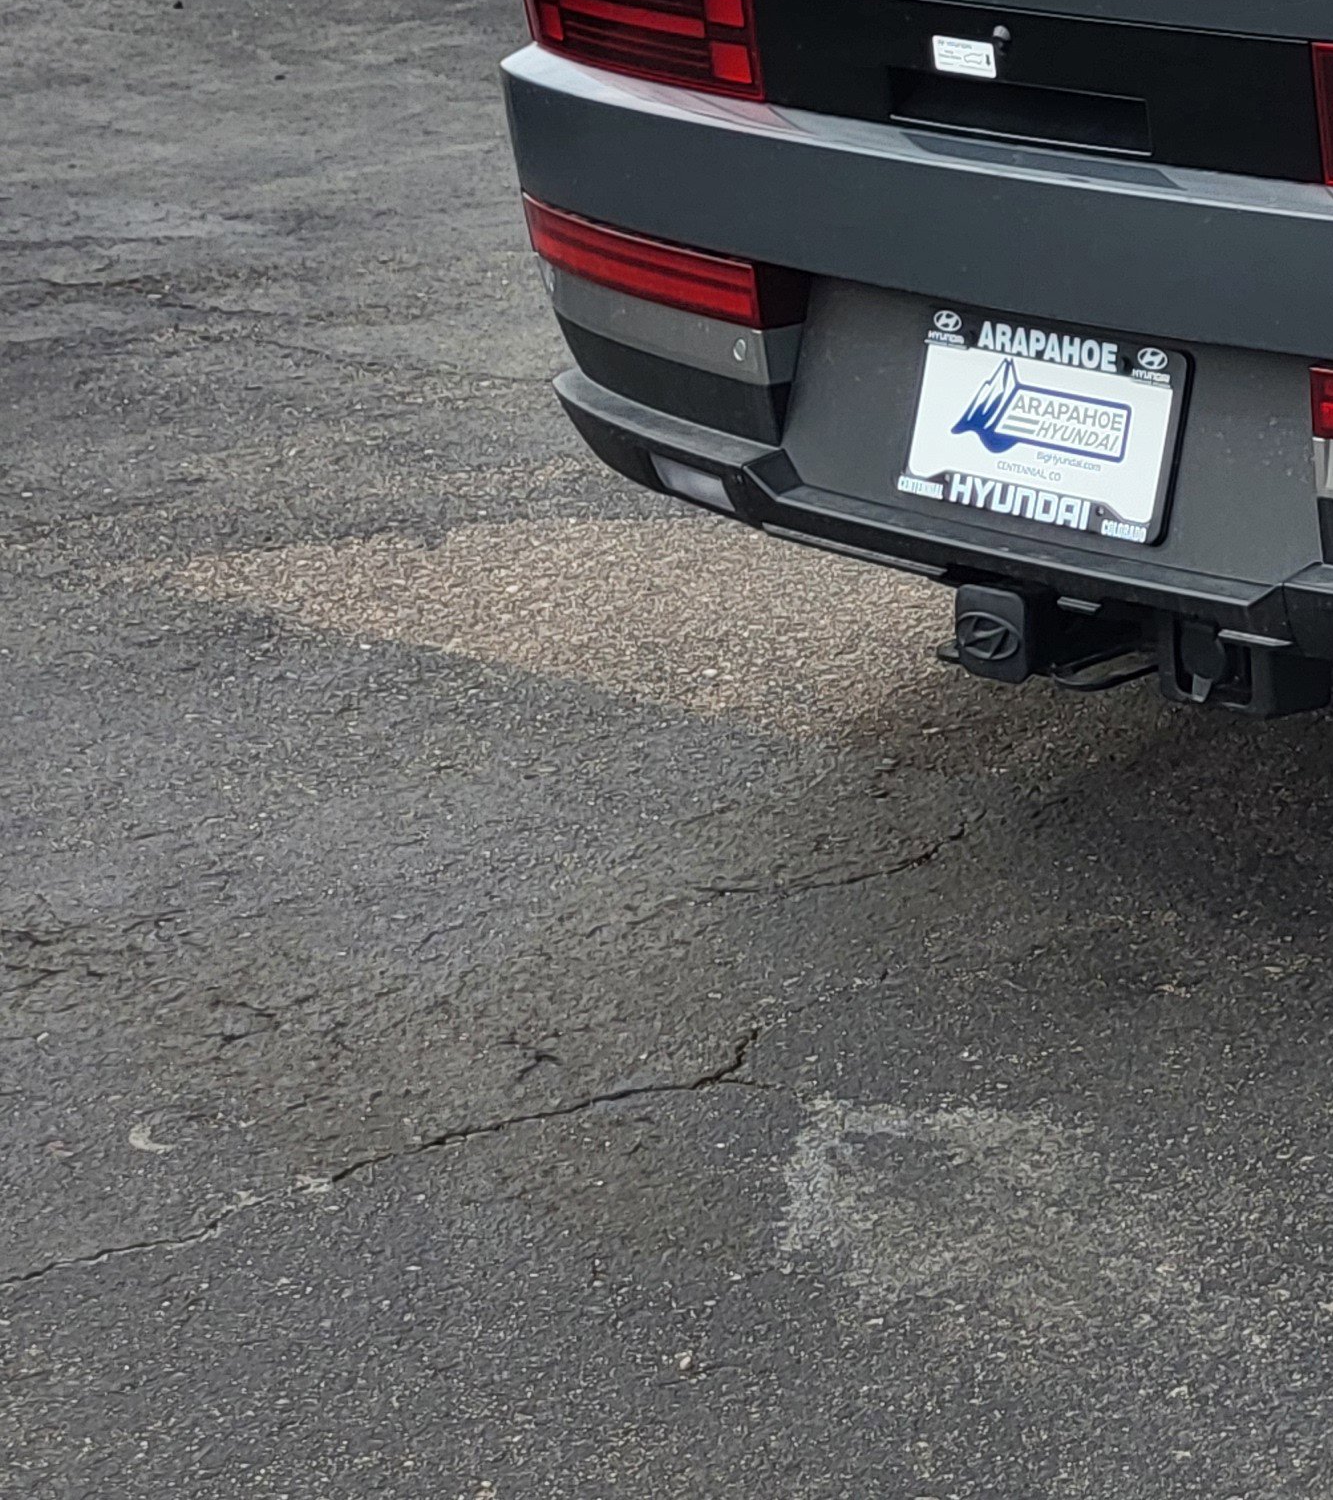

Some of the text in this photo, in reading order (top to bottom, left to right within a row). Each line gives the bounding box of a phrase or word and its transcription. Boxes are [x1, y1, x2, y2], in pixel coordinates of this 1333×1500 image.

[977, 320, 1118, 373] ARAPAHOE
[1012, 394, 1124, 432] ARAPAHOE
[1035, 420, 1120, 451] HYUNDAI
[996, 460, 1047, 480] CENTENNIAL
[949, 473, 1091, 531] HYUNDAI
[1101, 519, 1148, 544] COLORADO
